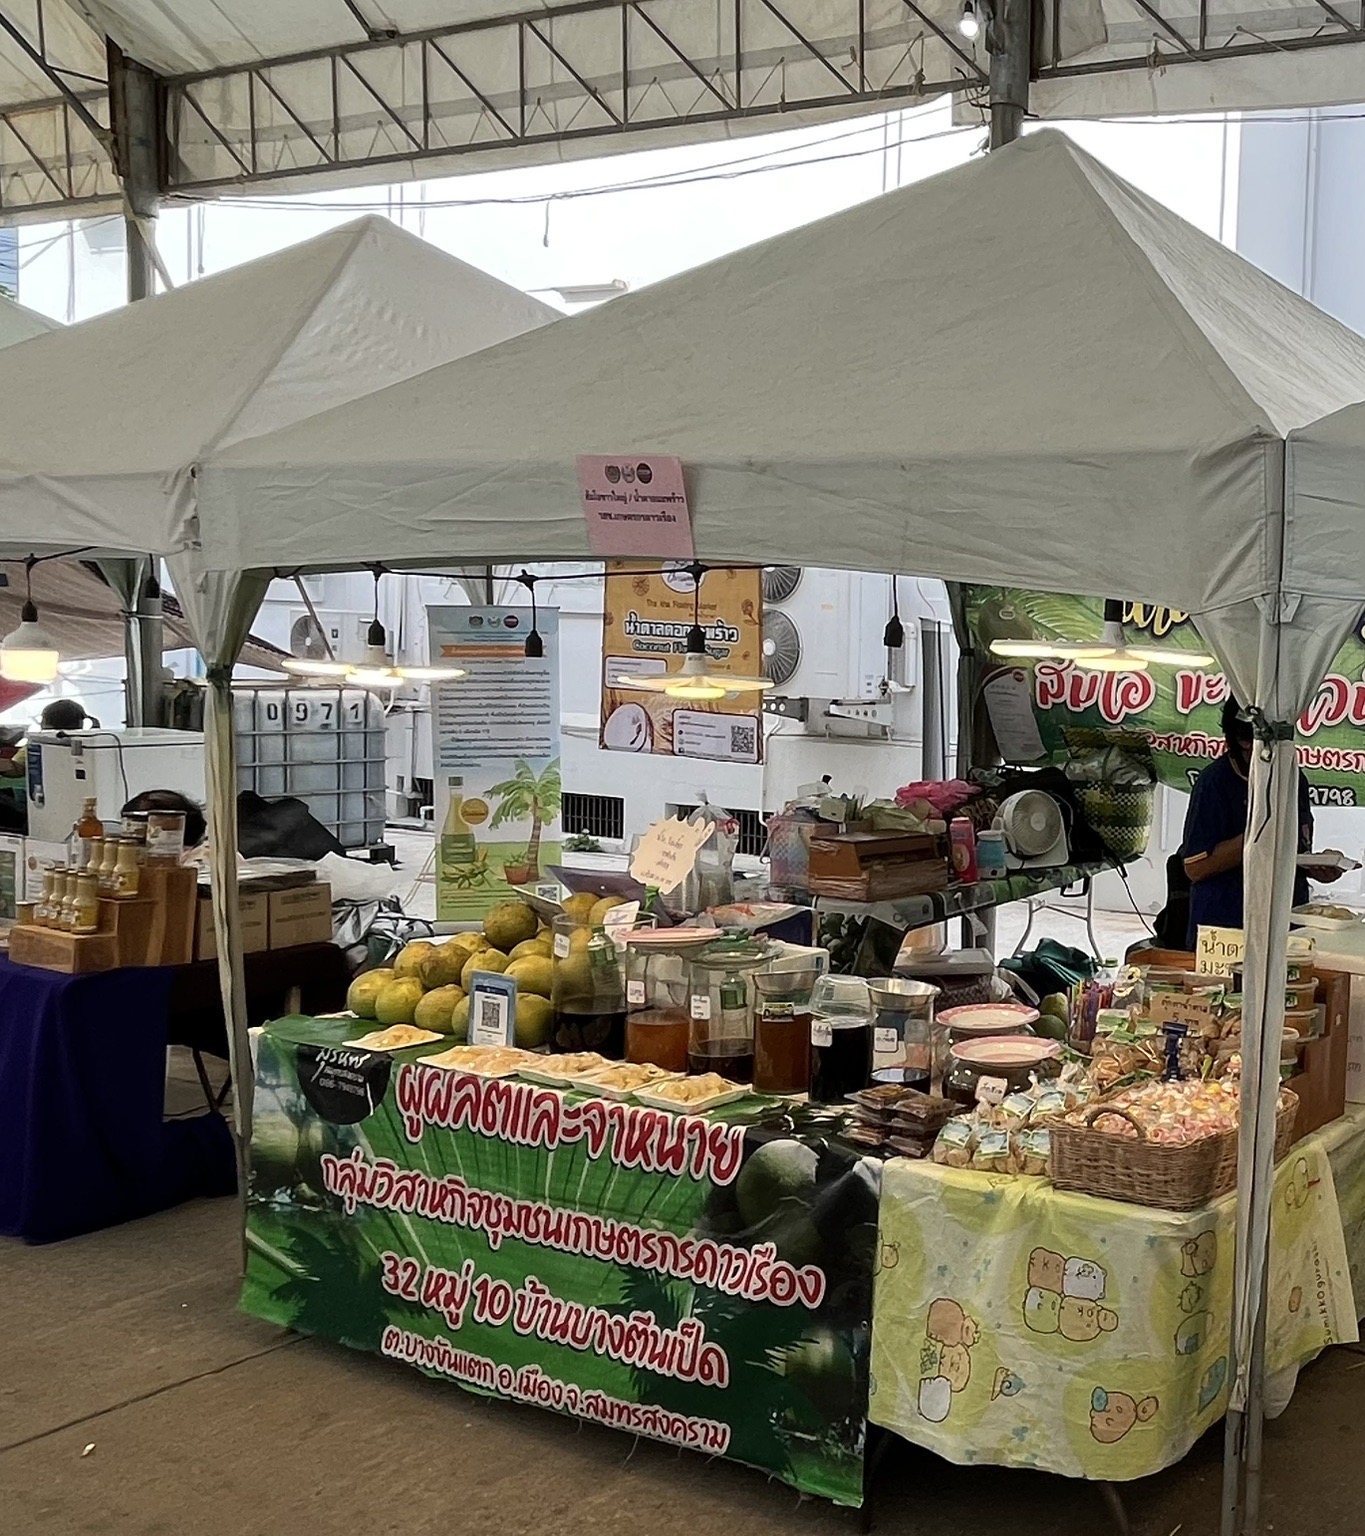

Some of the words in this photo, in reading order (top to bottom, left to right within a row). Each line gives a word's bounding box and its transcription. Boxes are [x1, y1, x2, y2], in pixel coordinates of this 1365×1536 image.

[321, 1150, 824, 1307] กลุ่มวิสาหกิจชุมชนเกษตรกรดาวเรือง
[382, 1327, 494, 1386] ต.บางขันแตก
[499, 1364, 562, 1405] อ.เมือง
[383, 1254, 420, 1298] 32
[423, 1260, 473, 1328] หมู่
[475, 1274, 511, 1325] 10
[516, 1277, 728, 1387] บ้านบางตีนเป็ด
